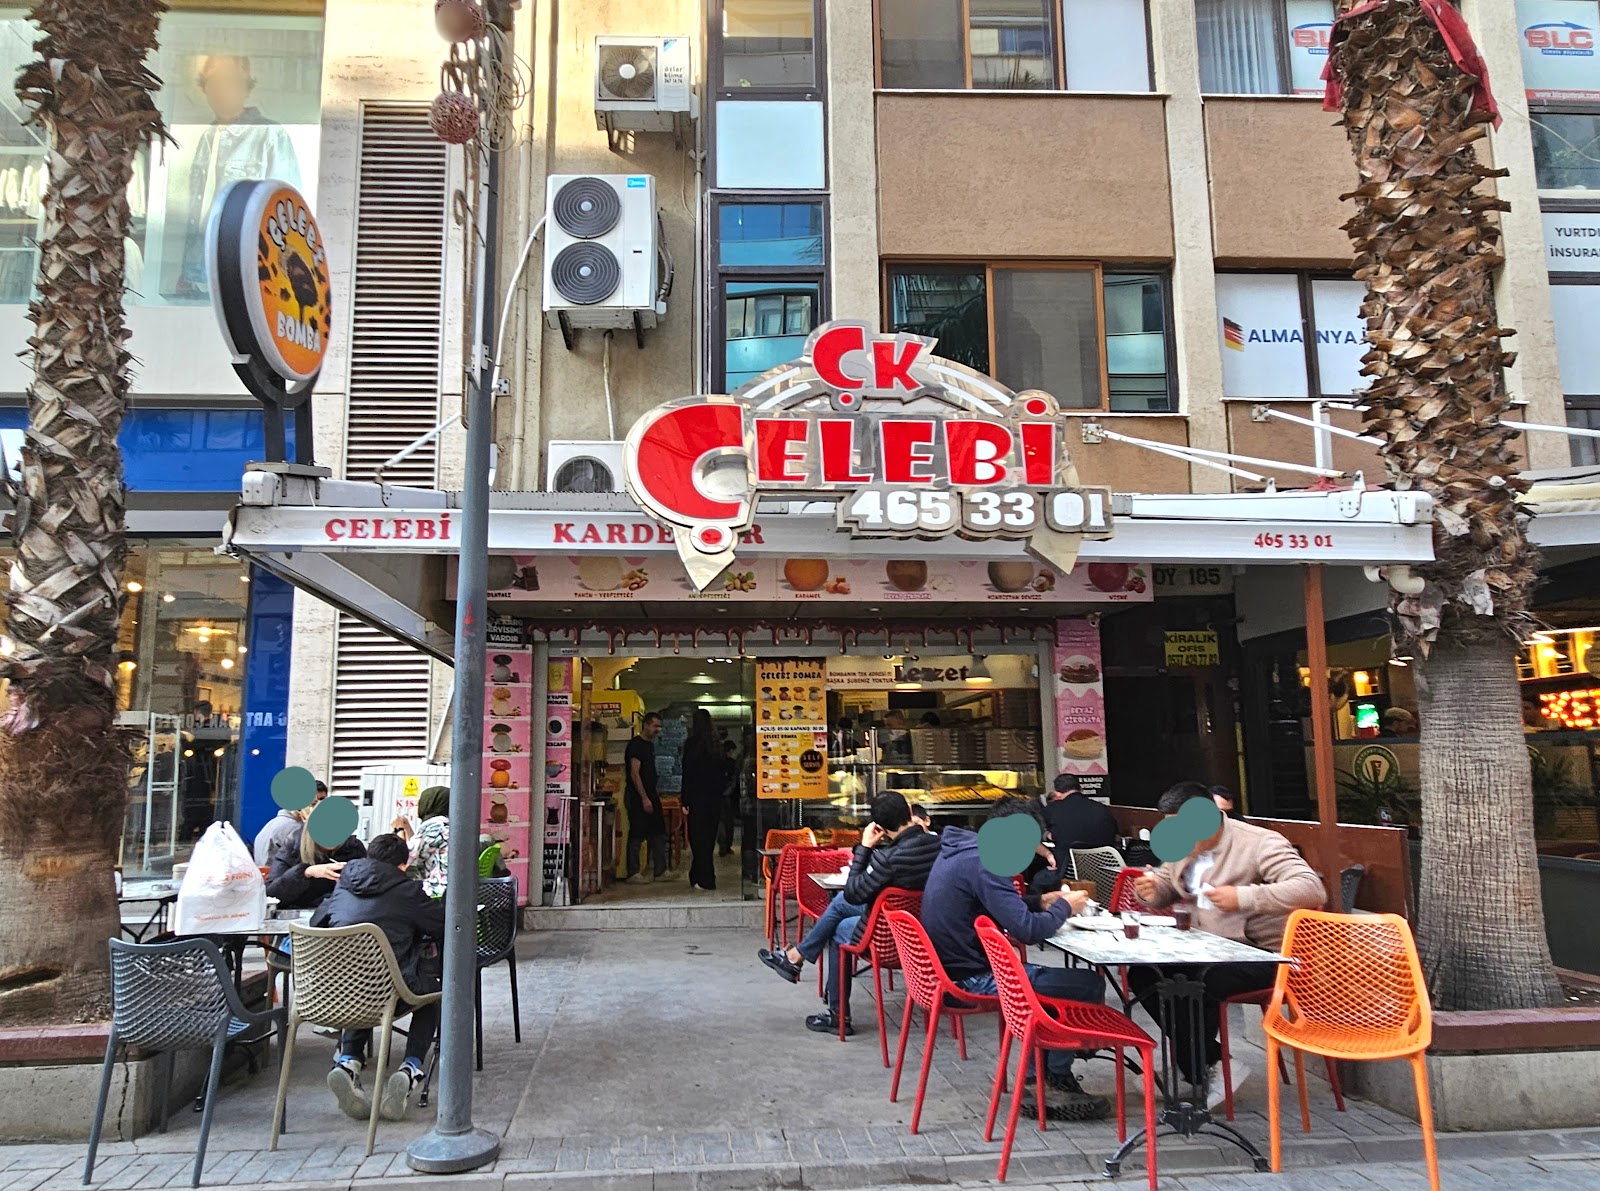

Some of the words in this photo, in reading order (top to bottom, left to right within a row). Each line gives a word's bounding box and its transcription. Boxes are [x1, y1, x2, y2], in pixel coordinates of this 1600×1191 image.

[1294, 29, 1329, 47] BL
[1527, 30, 1593, 49] BLC
[276, 310, 321, 353] BOMBA
[811, 325, 924, 405] ÇK
[634, 397, 1056, 548] ÇELEBİ
[850, 491, 951, 525] 465
[969, 491, 1036, 527] 33
[1053, 493, 1106, 528] 01
[324, 512, 452, 542] ÇELEBİ
[553, 522, 765, 545] KARDER
[1254, 532, 1284, 549] 465
[1288, 534, 1309, 549] 33
[1314, 534, 1333, 547] 01
[1189, 567, 1220, 586] 185
[490, 634, 519, 643] VARDIR
[1166, 633, 1216, 644] KİRALIK
[1178, 644, 1206, 653] OFİS
[793, 672, 822, 680] BOMBA
